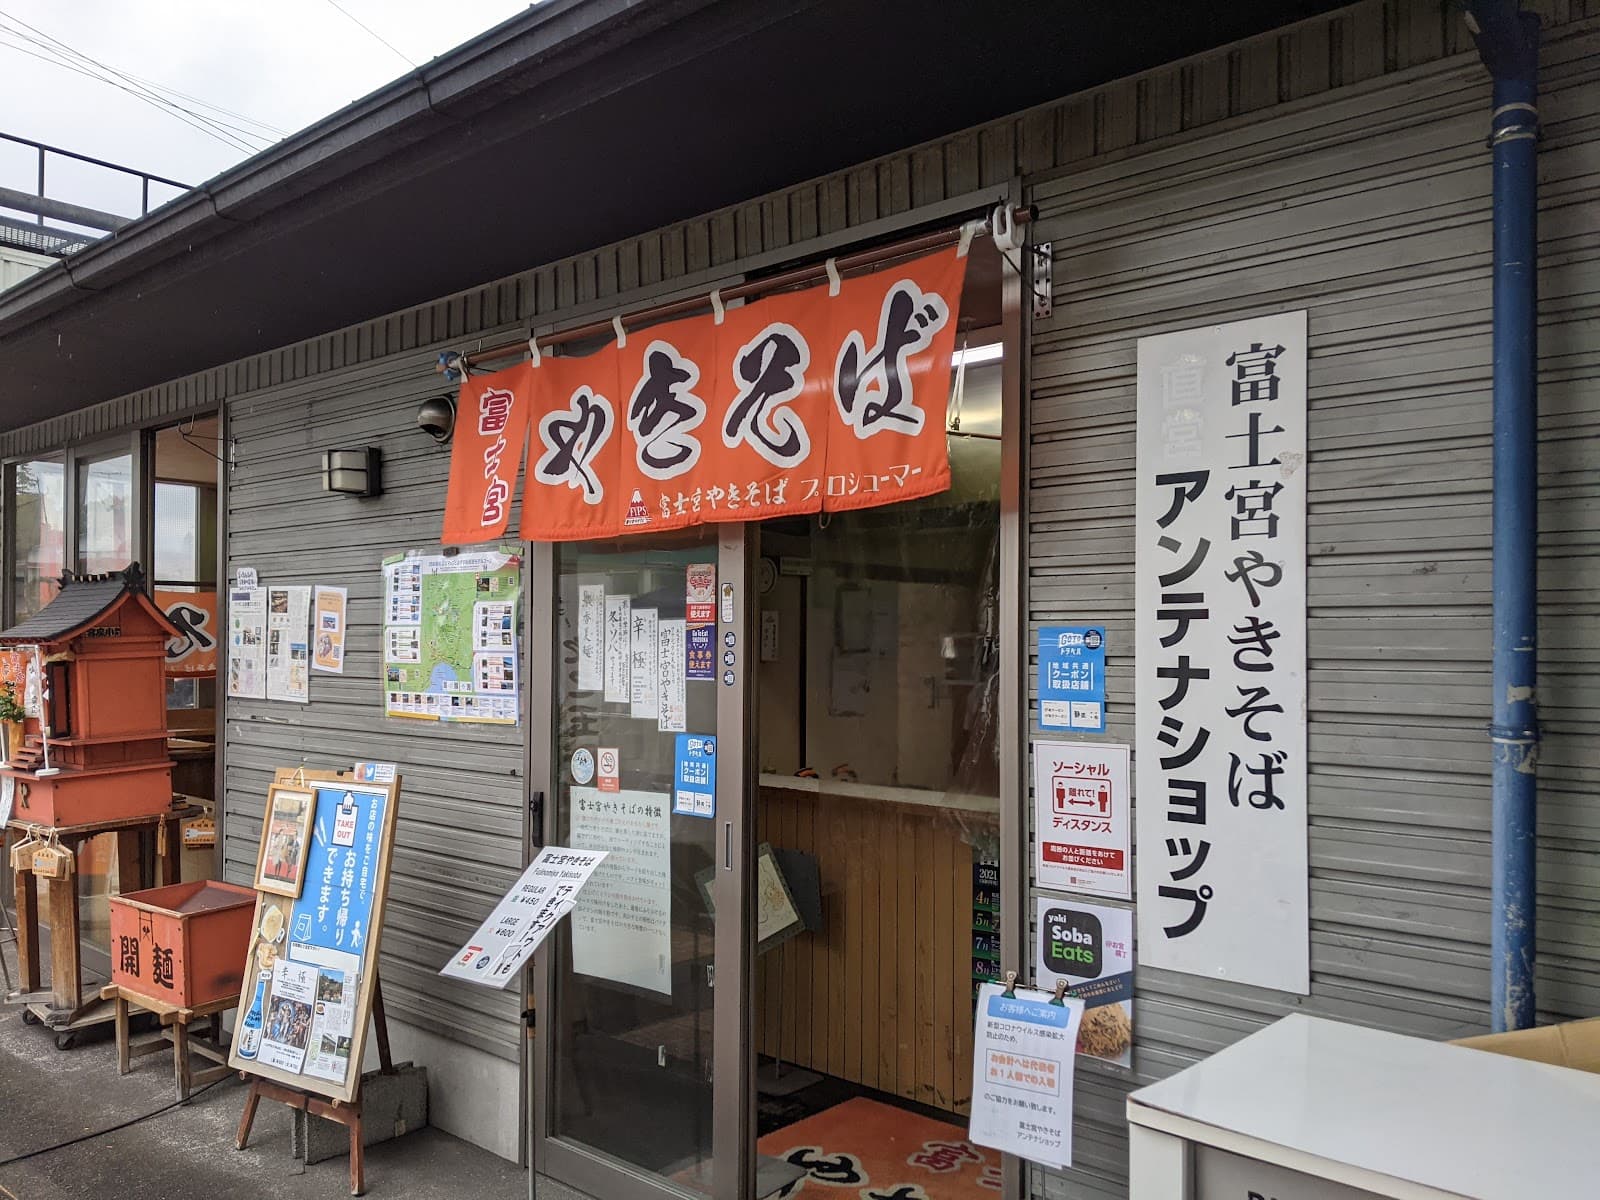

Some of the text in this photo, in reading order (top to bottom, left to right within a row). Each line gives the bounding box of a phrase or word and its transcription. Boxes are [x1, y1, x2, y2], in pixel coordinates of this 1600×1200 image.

[537, 282, 946, 501] やきそば
[801, 464, 922, 502] プロシューマー
[659, 477, 788, 519] 富士宮やきそば
[1224, 342, 1288, 811] 富士宮やきそば
[1060, 647, 1081, 656] トラベル
[1052, 670, 1089, 679] クーポン
[1052, 680, 1089, 690] 取扱店舗
[1155, 469, 1214, 939] アンテナショップ
[684, 768, 706, 776] クーポン
[1052, 761, 1110, 776] ソーシャル
[336, 819, 354, 829] TAKE
[1052, 816, 1112, 834] ディスタンス
[336, 830, 351, 839] OUT
[541, 853, 596, 867] 富士宮やきそば
[979, 868, 997, 880] 2021
[317, 847, 338, 932] できます。
[521, 884, 547, 895] REGULAR
[335, 850, 357, 946] お持ち帰り
[520, 895, 540, 906] ¥450
[500, 916, 520, 926] LARGE
[1048, 913, 1067, 924] yaki
[1051, 924, 1093, 946] Soba
[1051, 942, 1094, 964] Eats
[999, 1003, 1056, 1021] お客様へご案内
[987, 1020, 1065, 1041] 新型コロナウイルス感染拡大
[1018, 1121, 1061, 1137] 富士宮やきそば
[1016, 1131, 1061, 1148] アンテナショップ
